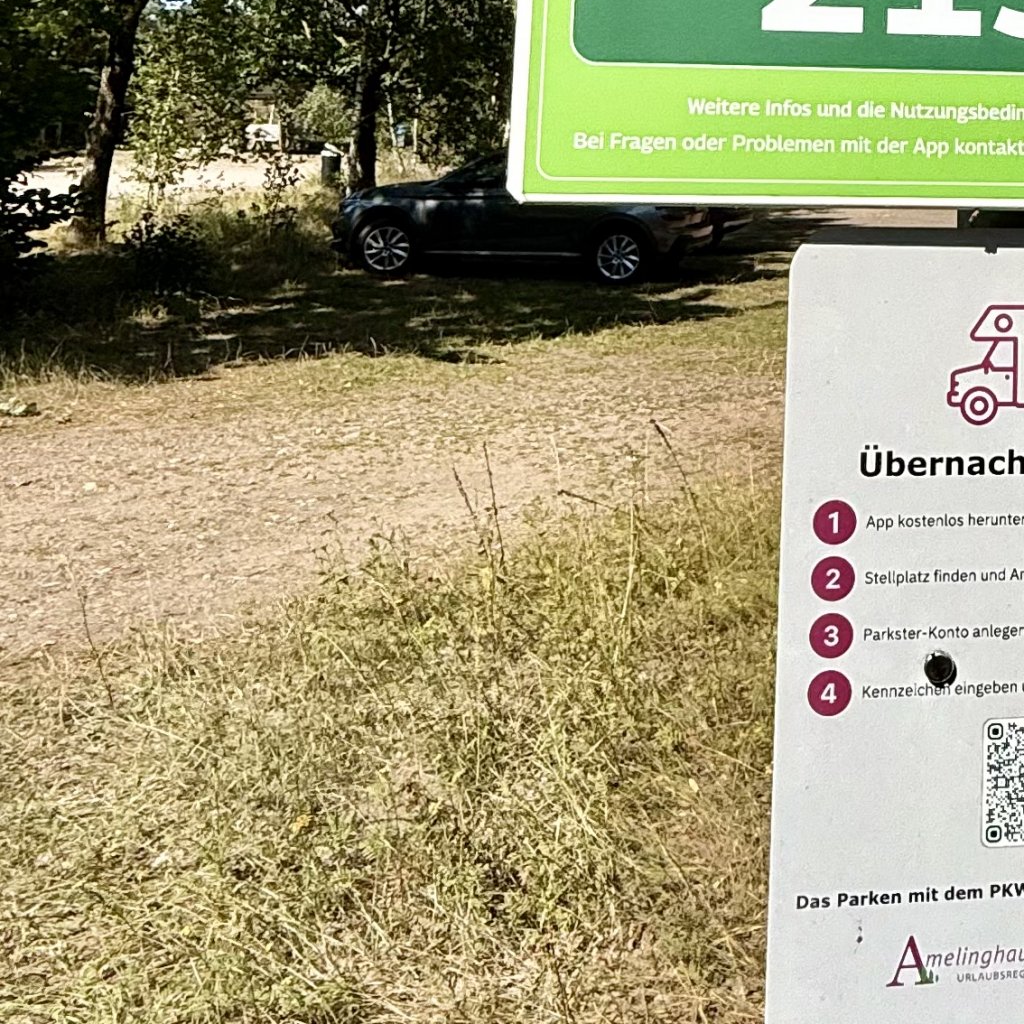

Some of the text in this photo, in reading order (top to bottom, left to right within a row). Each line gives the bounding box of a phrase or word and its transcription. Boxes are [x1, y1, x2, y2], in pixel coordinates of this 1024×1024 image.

[687, 96, 760, 117] Weitere
[765, 99, 812, 118] Infos
[817, 100, 852, 118] und
[857, 100, 886, 118] die
[572, 131, 604, 150] Bei
[609, 132, 677, 154] Fragen
[682, 134, 727, 151] oder
[732, 134, 835, 153] Problemen
[840, 136, 872, 153] mit
[876, 136, 908, 154] der
[912, 138, 950, 159] App
[828, 511, 840, 534] 1
[866, 515, 894, 531] App
[898, 513, 964, 528] kostenlos
[825, 568, 841, 589] 2
[865, 570, 930, 587] Stellplatz
[934, 568, 977, 583] finden
[980, 568, 1006, 582] und
[823, 625, 840, 647] 3
[863, 625, 969, 641] Parkster-Konto
[820, 683, 837, 704] 4
[862, 682, 950, 699] Kennzeichen
[954, 680, 1018, 698] eingeben
[796, 895, 831, 910] Das
[837, 890, 901, 908] Parken
[908, 886, 938, 903] mit
[944, 885, 983, 901] dem
